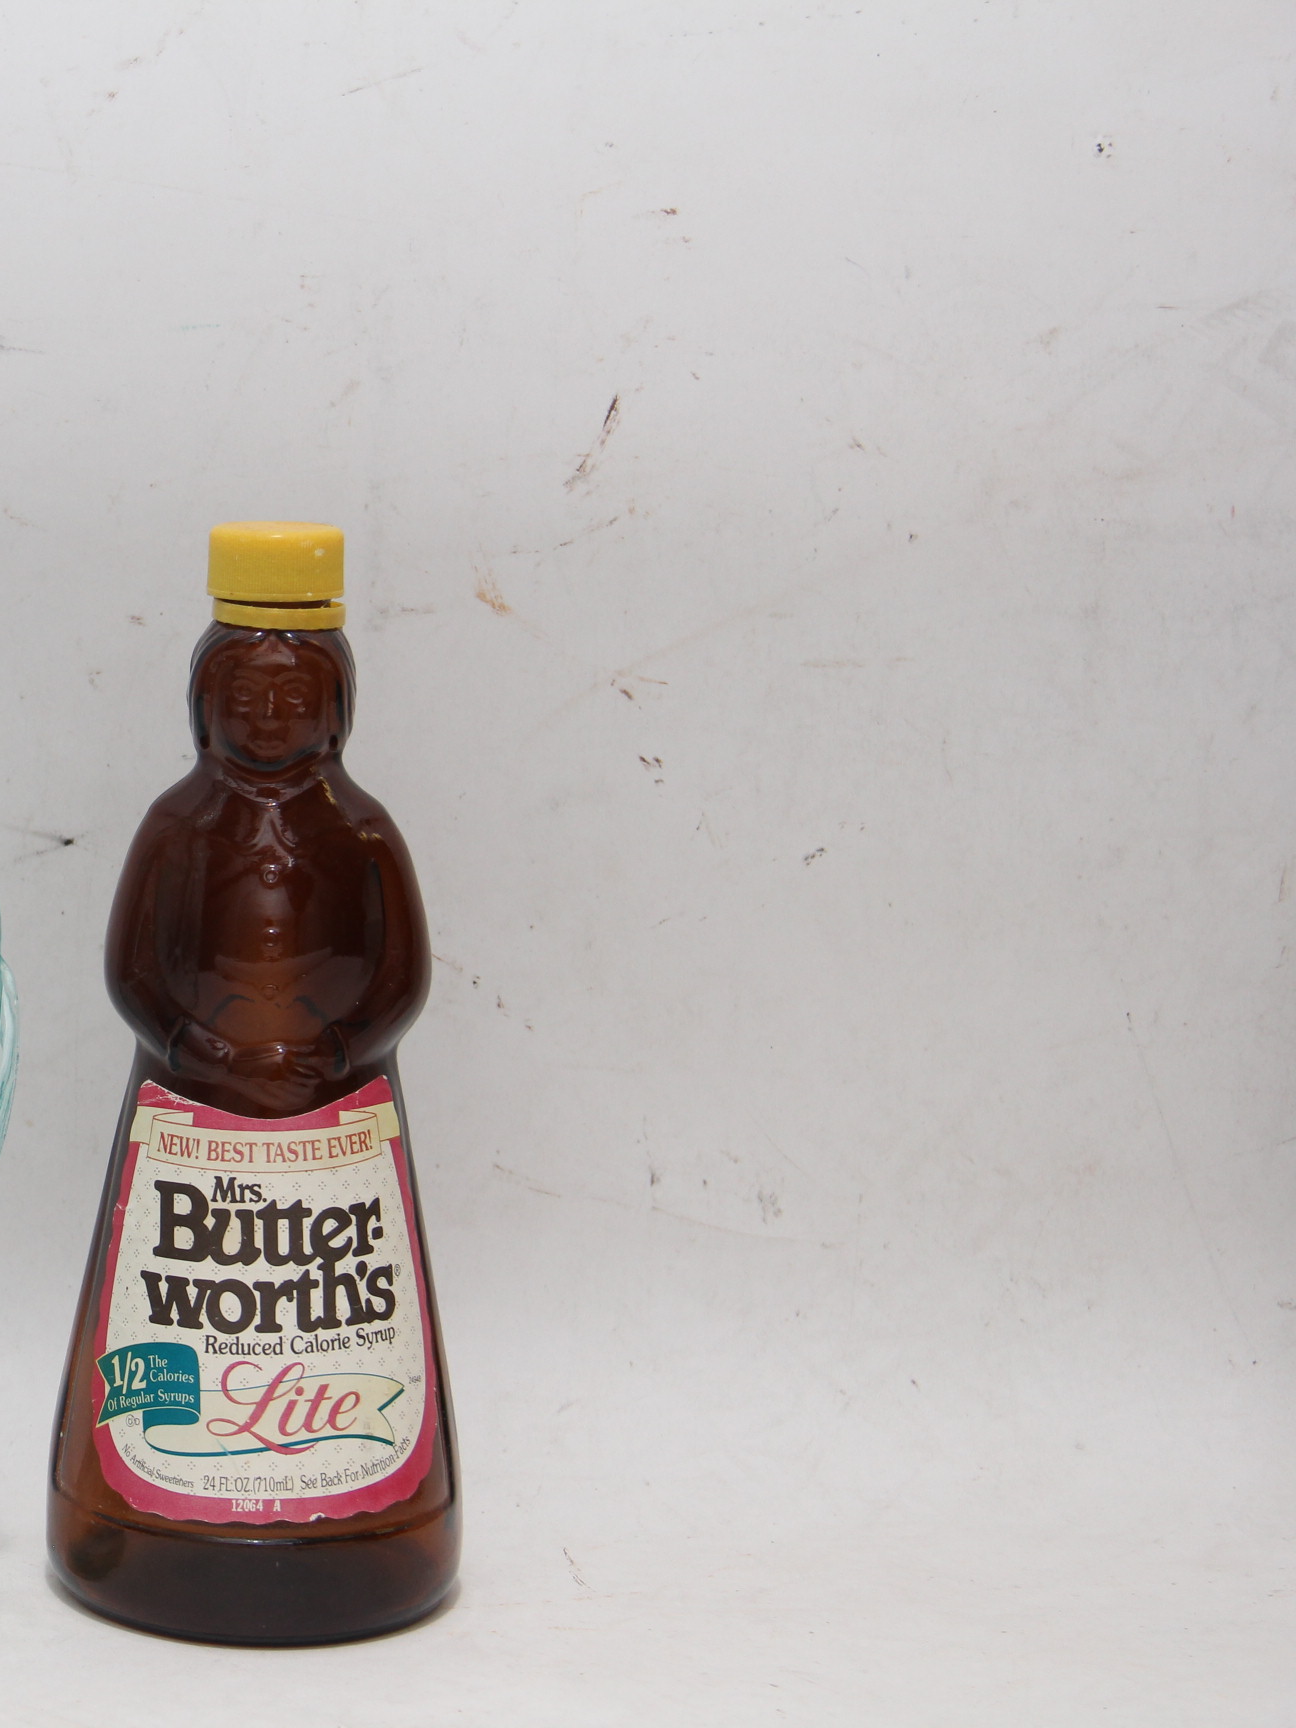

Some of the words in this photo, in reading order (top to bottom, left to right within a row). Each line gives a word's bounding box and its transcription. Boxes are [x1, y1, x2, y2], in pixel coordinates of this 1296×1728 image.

[157, 1131, 201, 1159] NEW!
[207, 1140, 255, 1163] BEST
[262, 1139, 323, 1163] TASTE
[326, 1129, 373, 1157] EVER!
[210, 1176, 267, 1203] Mrs.
[204, 1335, 284, 1356] Reduced
[290, 1333, 351, 1353] Calorie
[356, 1326, 396, 1349] Syrup
[111, 1351, 147, 1394] 1/2
[148, 1355, 168, 1368] The
[149, 1369, 195, 1384] Calories
[107, 1397, 118, 1411] Of
[119, 1391, 155, 1408] Regular
[157, 1389, 195, 1404] Syrups
[206, 1360, 361, 1455] Lite
[122, 1443, 131, 1458] No
[130, 1454, 156, 1477] Artificial
[155, 1469, 195, 1488] Sweeteners
[299, 1474, 318, 1490] See
[320, 1470, 343, 1487] Back
[344, 1468, 360, 1483] For
[360, 1453, 396, 1479] Nutrition
[393, 1436, 411, 1459] Facts
[202, 1475, 216, 1490] 24
[231, 1499, 264, 1512] 12064
[273, 1499, 281, 1512] A
